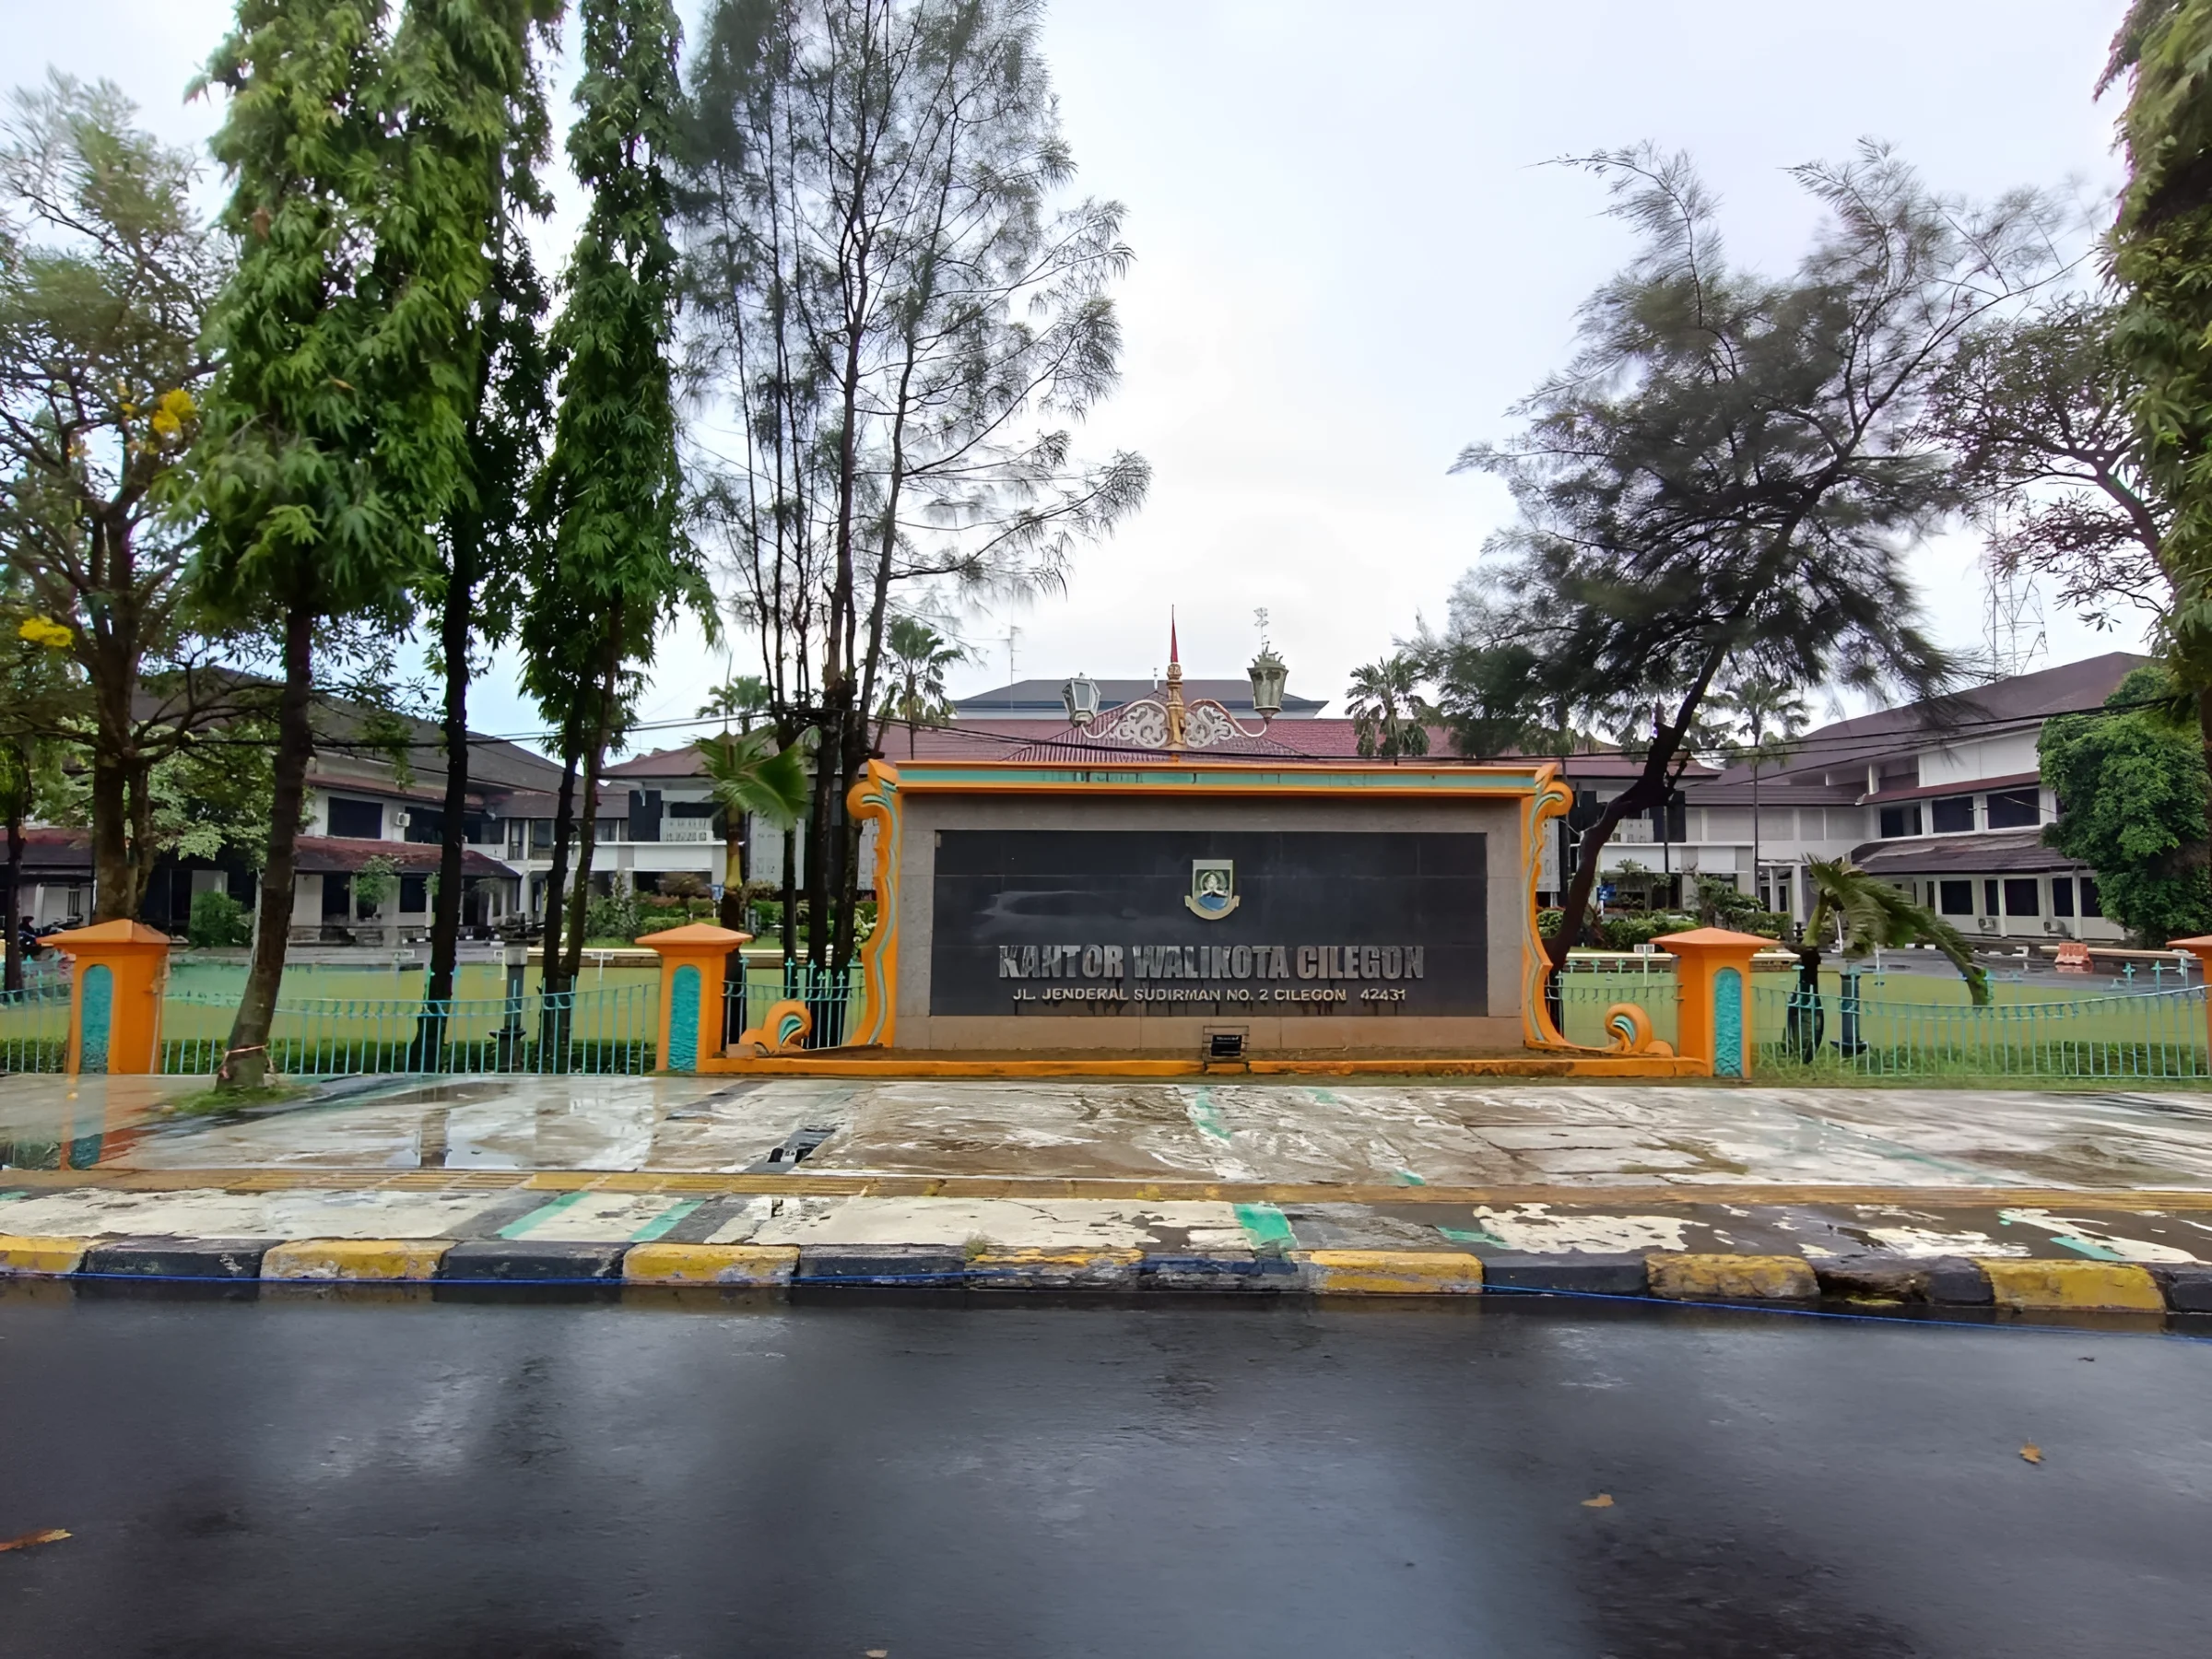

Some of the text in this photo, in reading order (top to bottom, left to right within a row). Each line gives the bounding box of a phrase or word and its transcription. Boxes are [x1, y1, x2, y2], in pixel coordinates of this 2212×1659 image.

[998, 945, 1424, 980] KANTOR WALIKOTA CILEGON
[1041, 988, 1129, 1001] JENDERAL
[1134, 988, 1221, 1001] SUDIRMAN
[1227, 989, 1254, 1001] NO.
[1259, 989, 1269, 1001] 2
[1274, 989, 1347, 1001] CILEGON
[1359, 988, 1406, 1001] 42431
